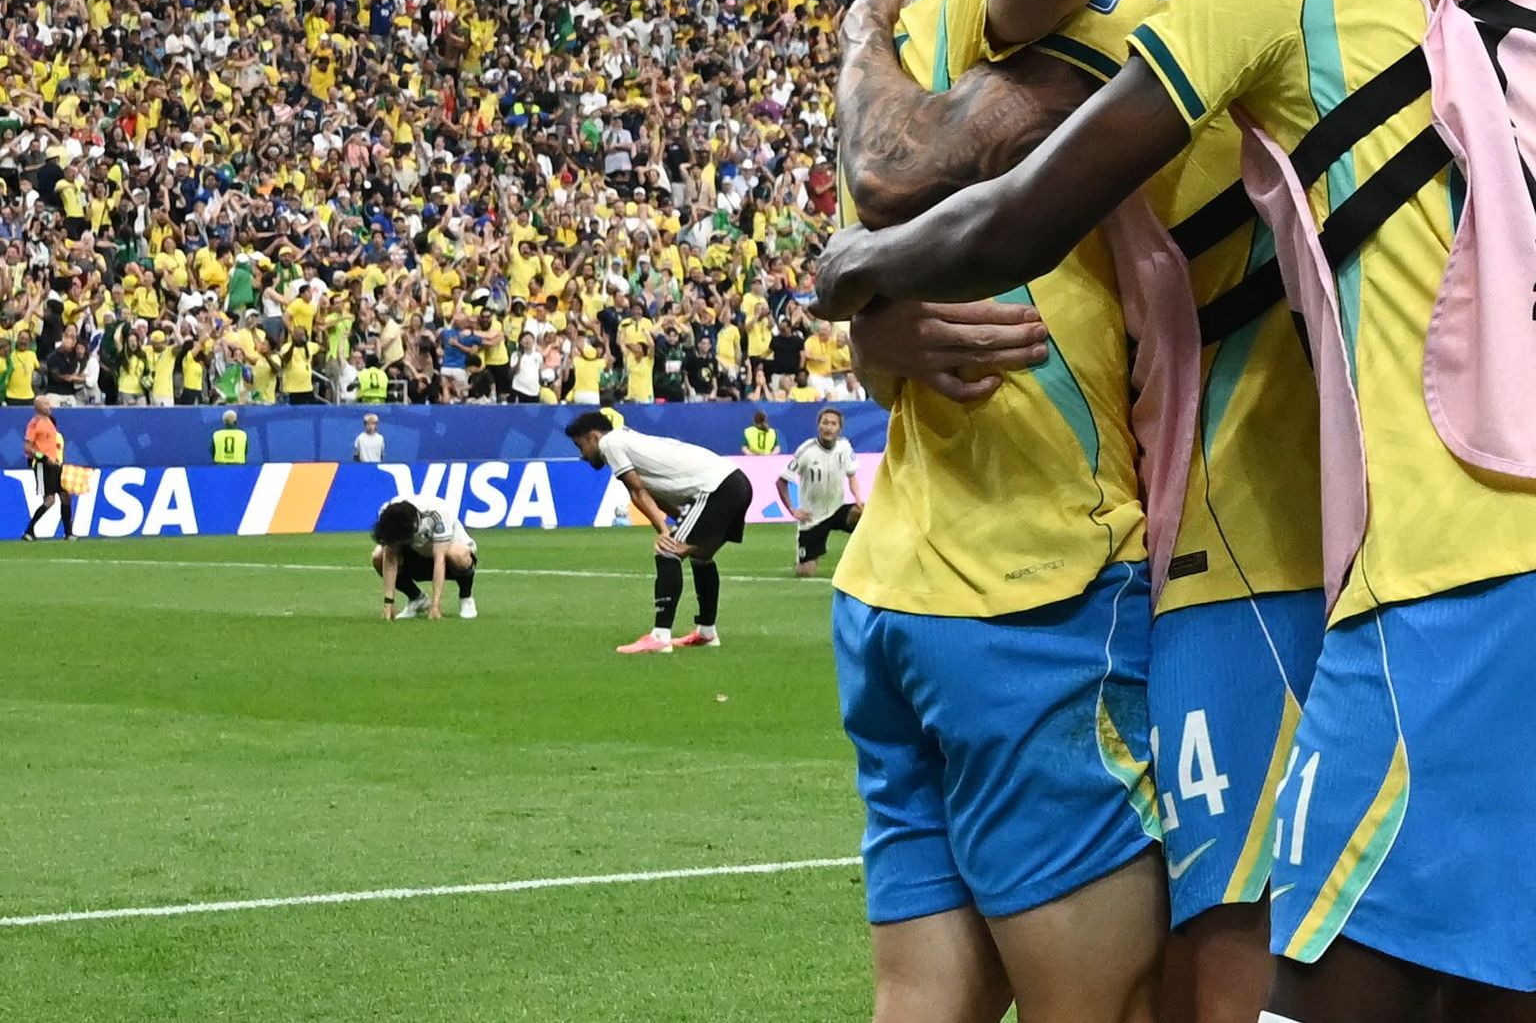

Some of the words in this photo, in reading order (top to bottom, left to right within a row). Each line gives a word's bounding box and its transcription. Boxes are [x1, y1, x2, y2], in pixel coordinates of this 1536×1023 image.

[4, 466, 199, 538] VISA
[377, 461, 558, 529] VISA
[809, 468, 822, 483] 11
